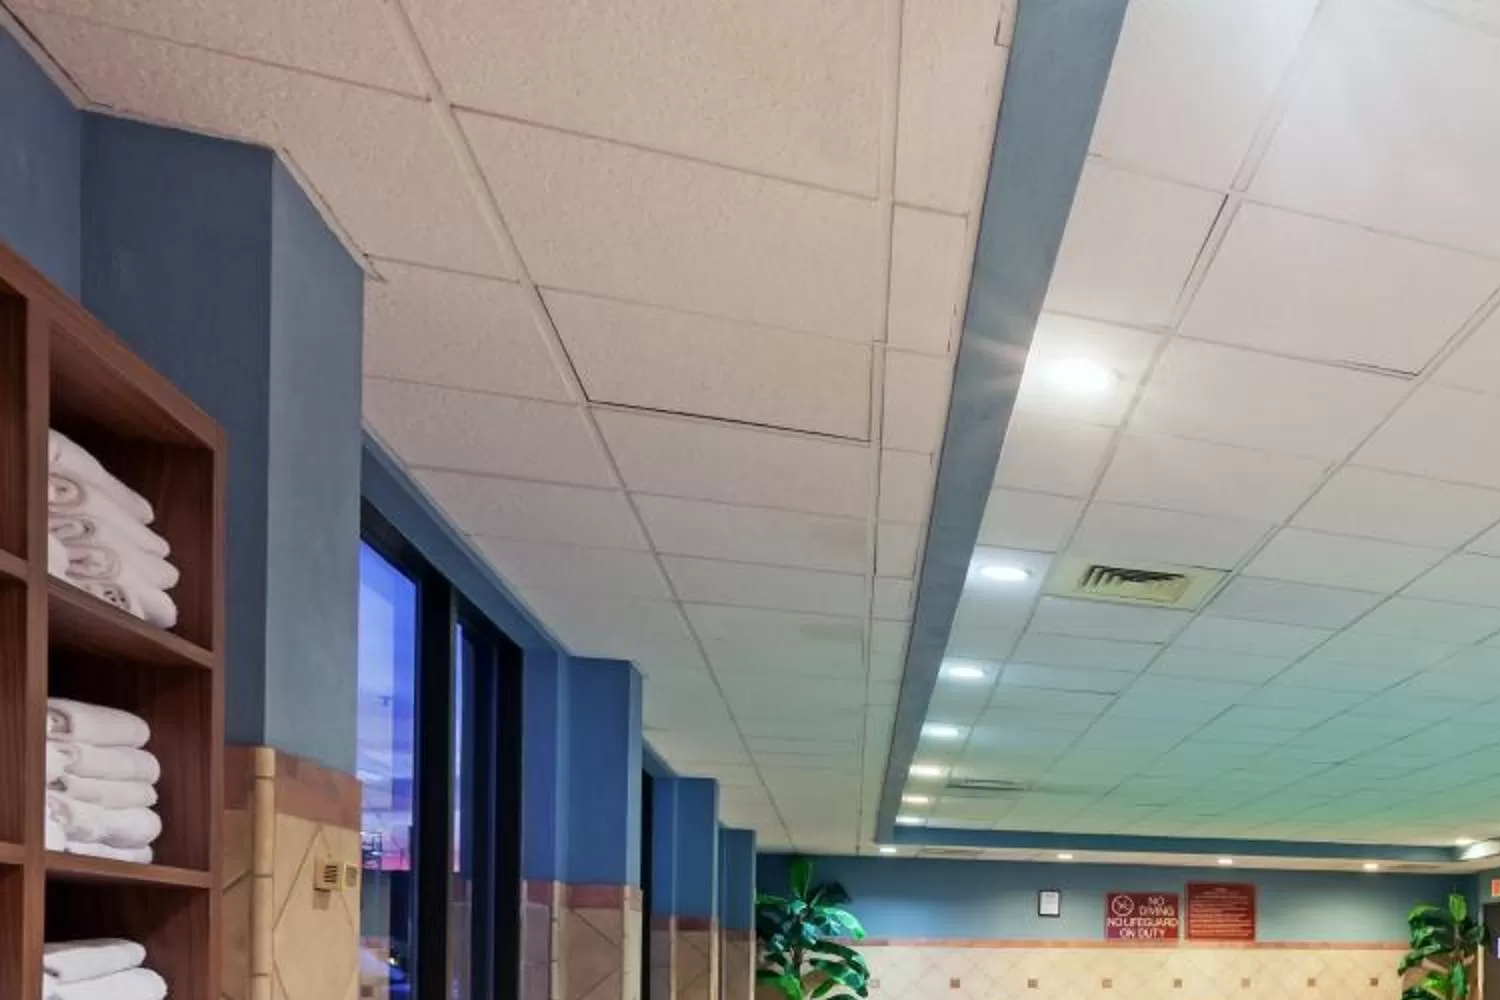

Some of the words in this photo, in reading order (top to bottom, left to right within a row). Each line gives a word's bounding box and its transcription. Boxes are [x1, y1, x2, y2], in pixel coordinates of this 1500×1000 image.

[1148, 895, 1165, 906] NO
[1107, 917, 1123, 928] NO
[1123, 917, 1178, 928] LIFEGUARD
[1119, 927, 1136, 939] ON
[1137, 927, 1166, 939] DUTY
